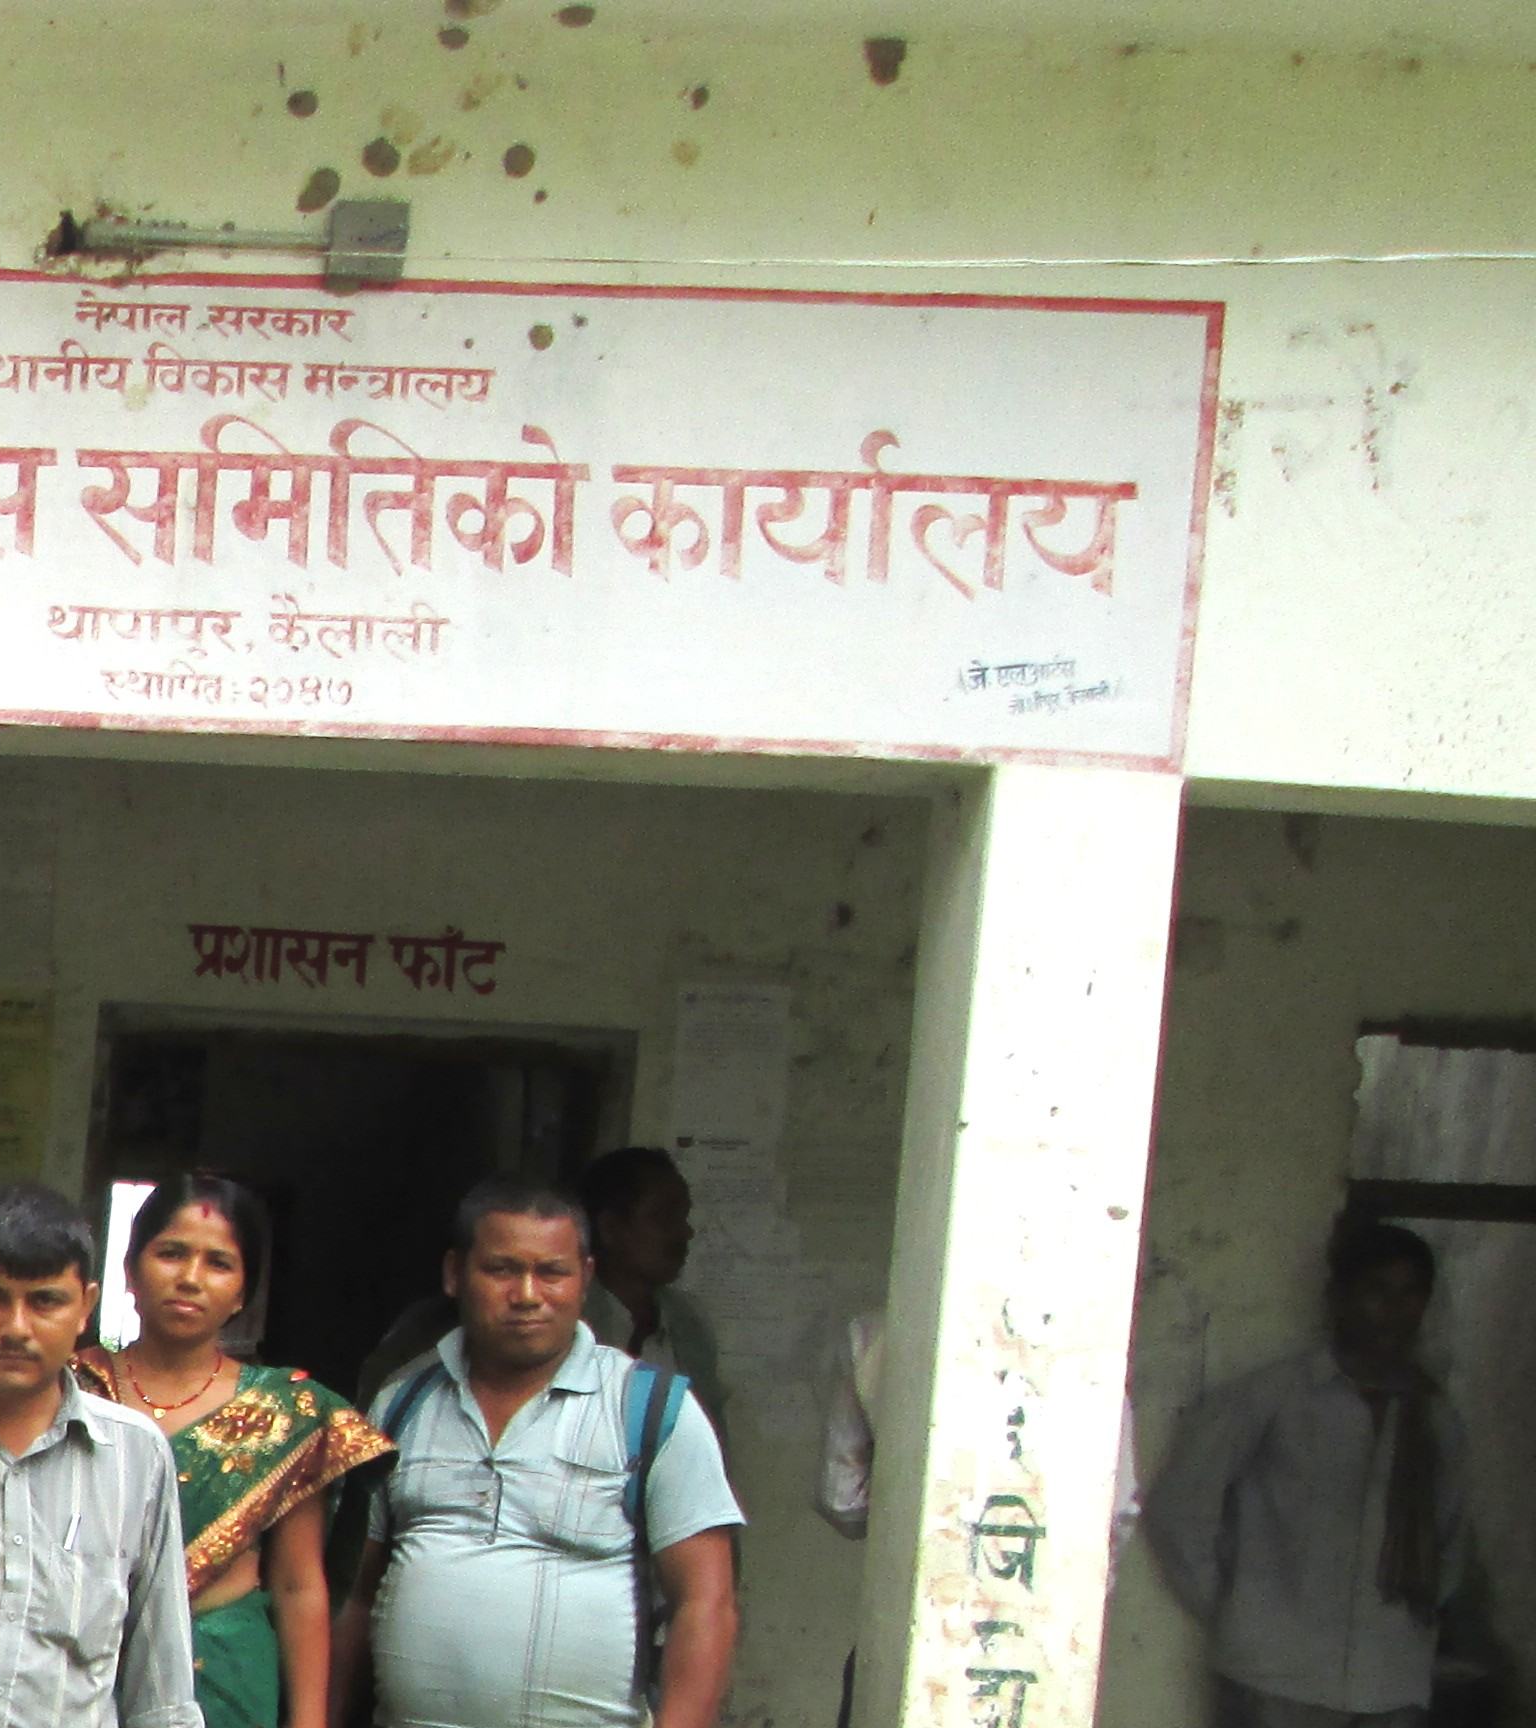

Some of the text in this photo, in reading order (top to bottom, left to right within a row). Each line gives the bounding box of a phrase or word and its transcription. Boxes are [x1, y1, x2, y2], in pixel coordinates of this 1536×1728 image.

[75, 289, 356, 343] नेपाल सरकार
[144, 341, 294, 400] विकास
[304, 360, 497, 411] मन्त्रालय
[78, 411, 591, 580] समितिको
[608, 427, 1140, 602] कार्यालय
[269, 592, 450, 662] कैलाली
[187, 923, 507, 996] प्रशासन फाँट
